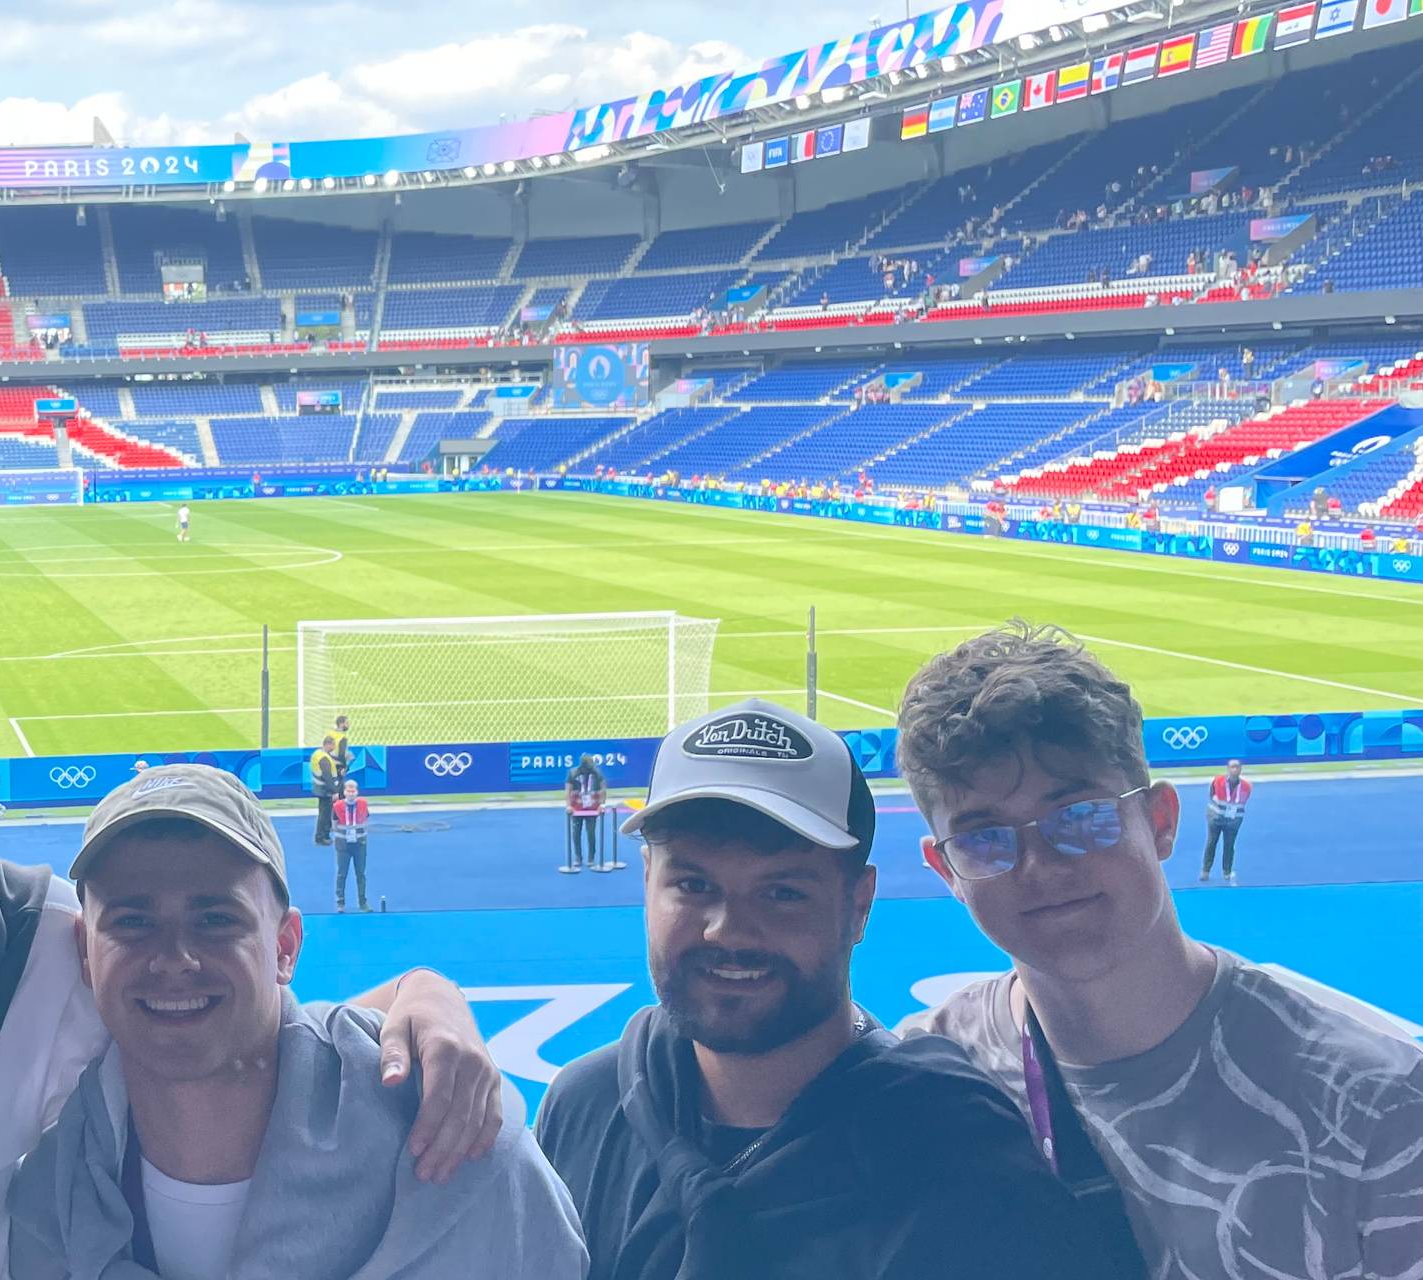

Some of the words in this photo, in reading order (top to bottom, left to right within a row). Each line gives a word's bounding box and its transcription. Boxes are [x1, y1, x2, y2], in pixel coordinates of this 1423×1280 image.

[24, 160, 110, 177] PARIS
[120, 156, 198, 175] 2024
[699, 721, 732, 745] Von
[731, 718, 793, 751] Dutch
[717, 747, 768, 757] ORIGINALS
[521, 754, 574, 769] PARIS
